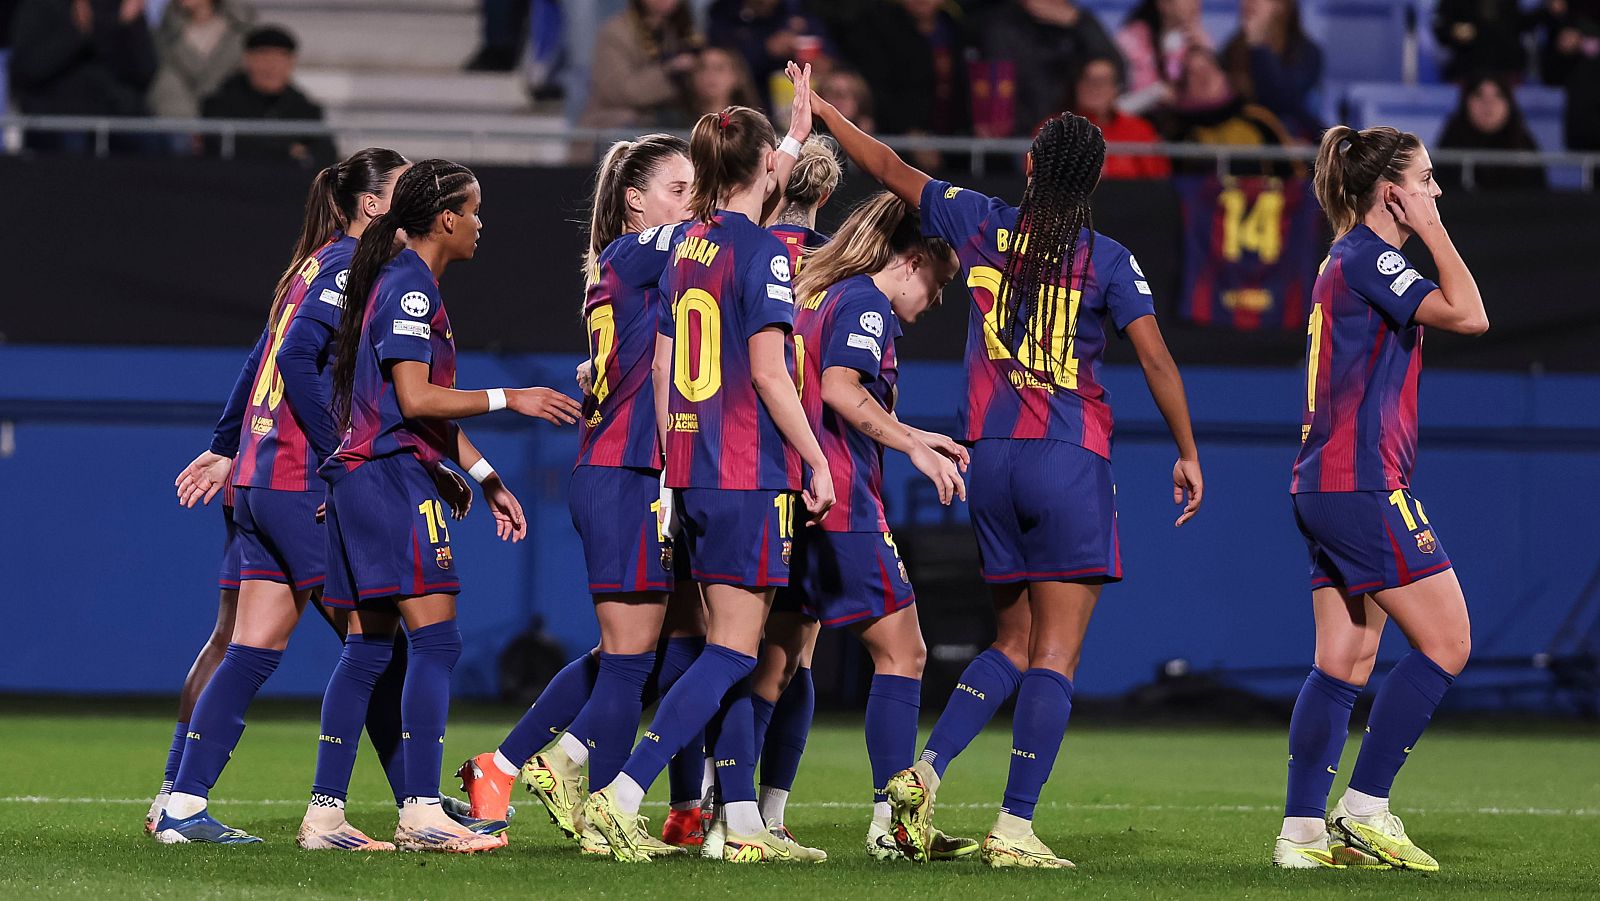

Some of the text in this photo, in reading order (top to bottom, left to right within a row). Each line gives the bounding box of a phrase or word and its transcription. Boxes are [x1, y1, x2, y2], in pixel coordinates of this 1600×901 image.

[1219, 189, 1284, 264] 14
[587, 304, 615, 405] 7
[671, 288, 723, 403] 0
[967, 265, 1082, 390] 24
[418, 499, 450, 544] 19
